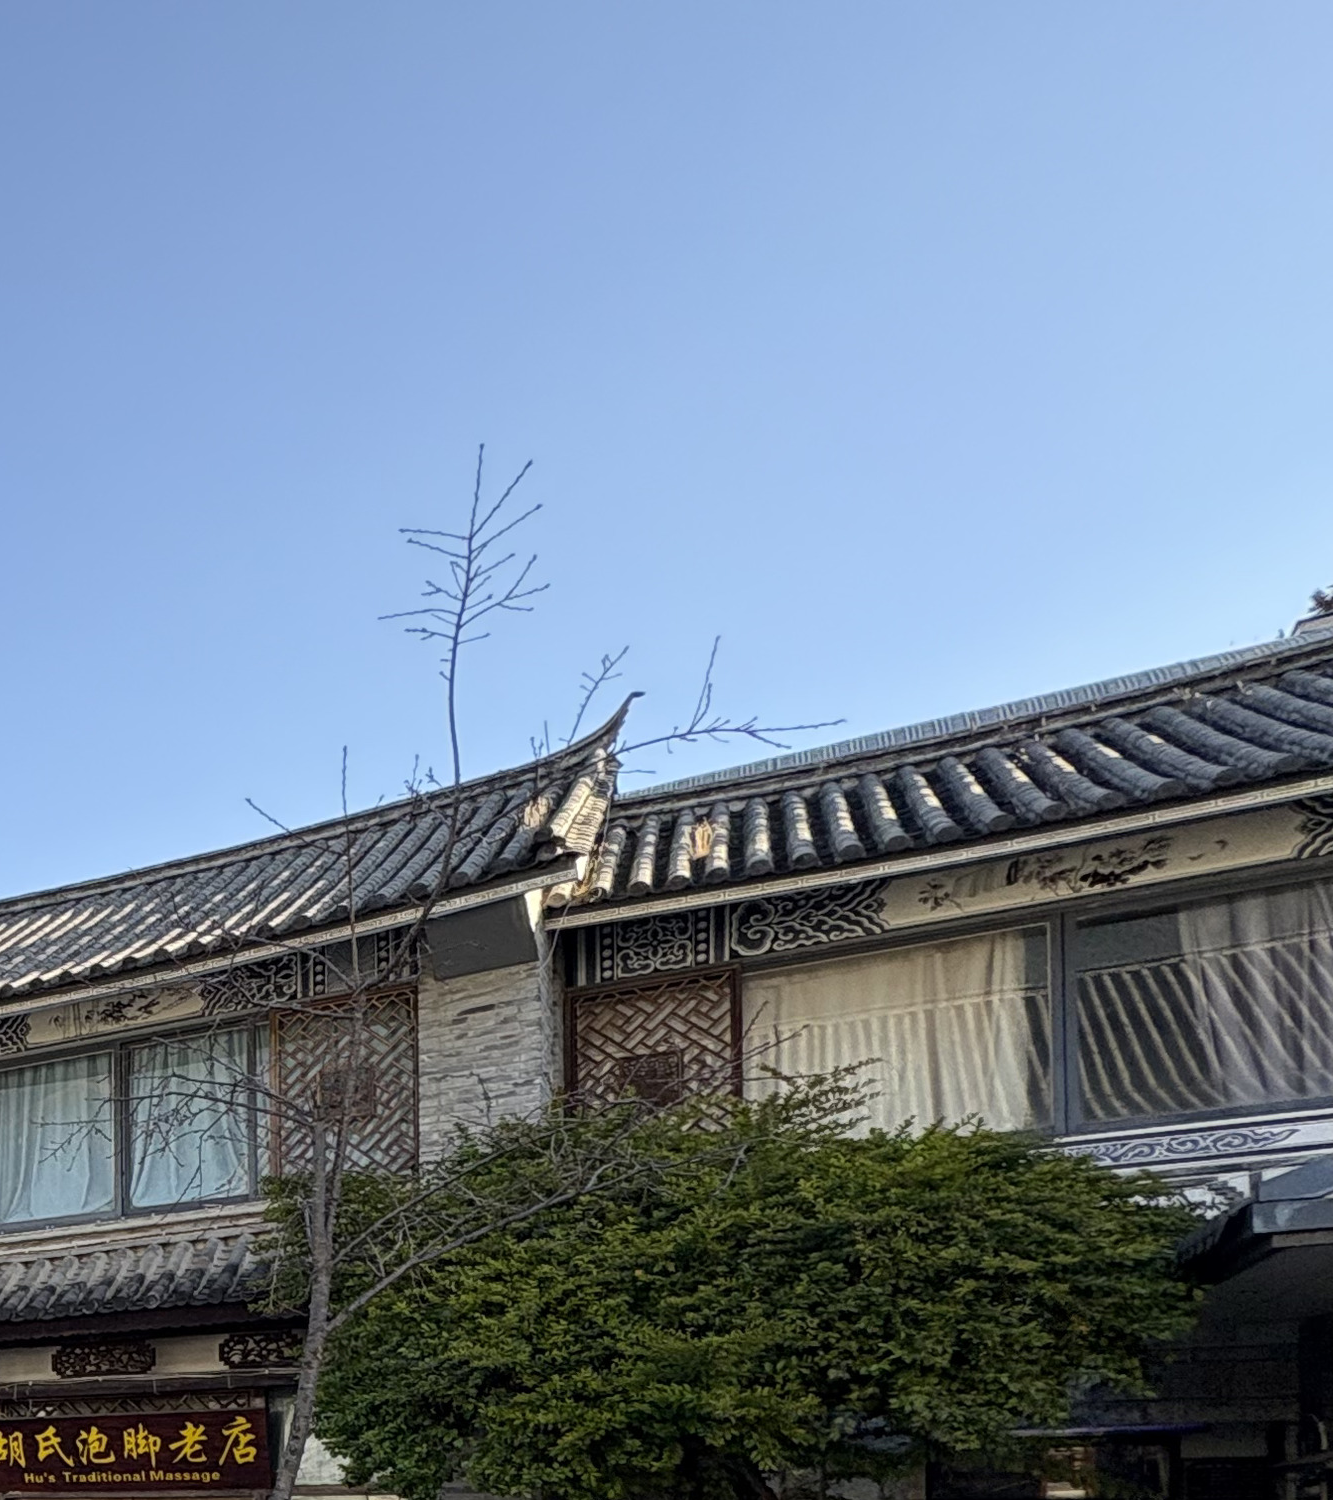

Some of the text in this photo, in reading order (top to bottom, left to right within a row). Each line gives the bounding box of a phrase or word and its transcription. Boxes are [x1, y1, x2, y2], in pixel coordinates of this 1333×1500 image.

[24, 1469, 221, 1483] Hu's Traditional Massage
